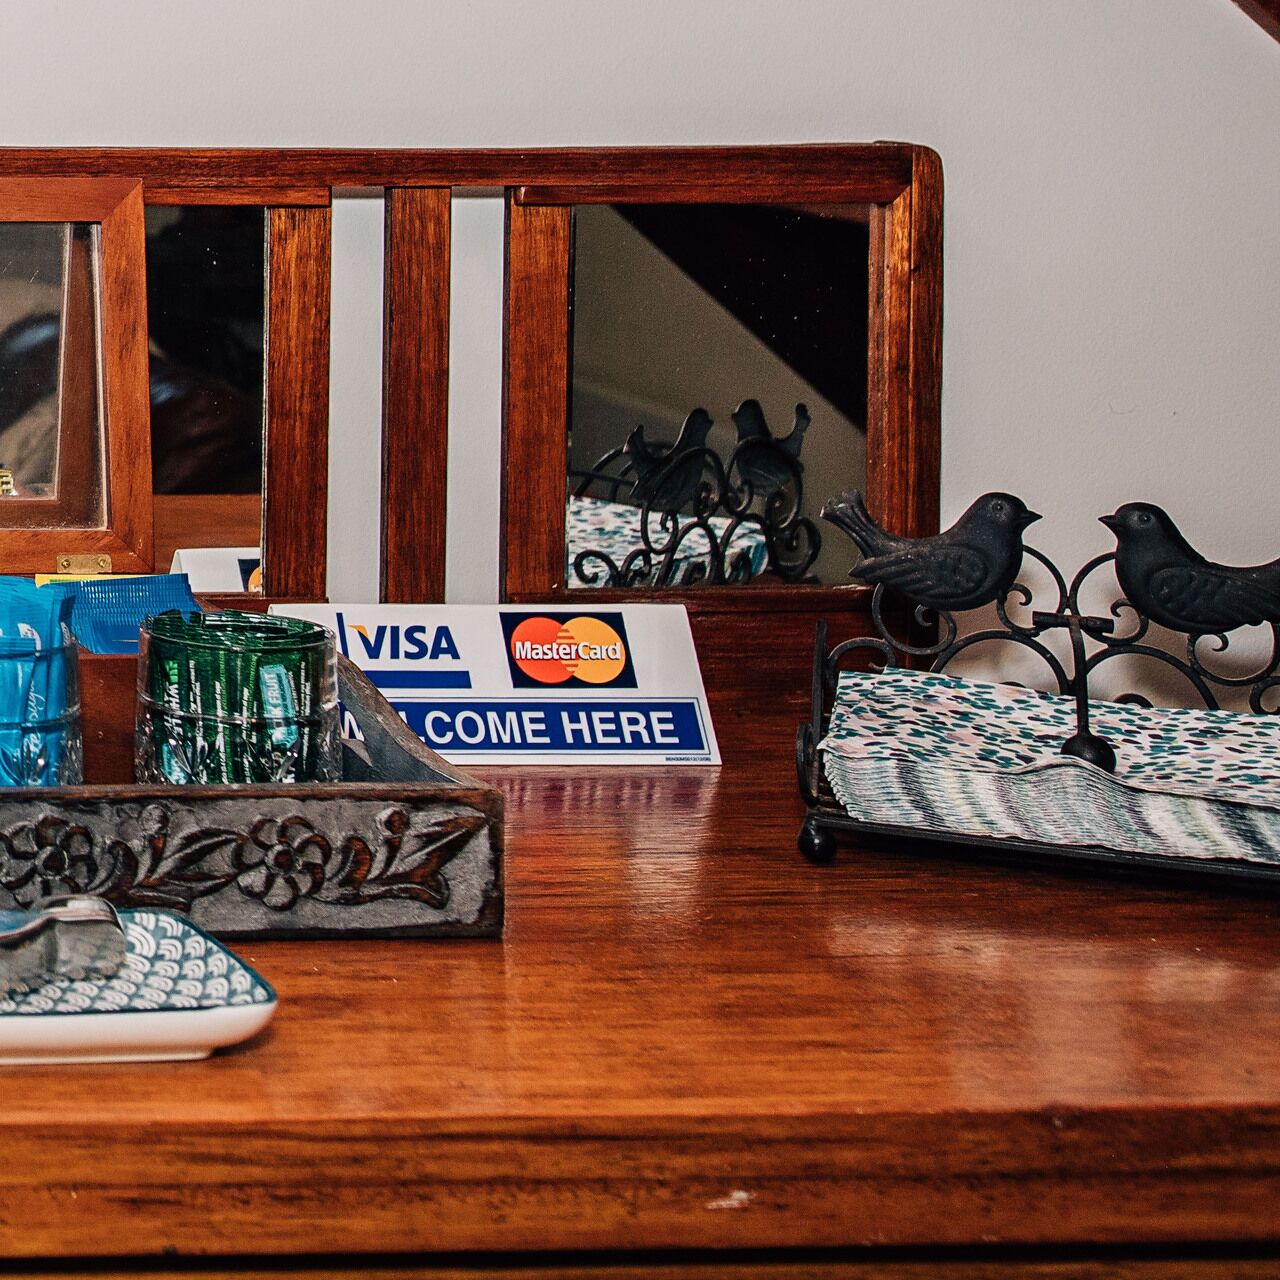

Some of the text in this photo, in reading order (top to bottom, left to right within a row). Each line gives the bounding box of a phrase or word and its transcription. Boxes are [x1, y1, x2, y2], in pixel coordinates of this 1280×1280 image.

[348, 624, 460, 660] VISA
[514, 640, 623, 662] MasterCard
[559, 711, 680, 744] HERE
